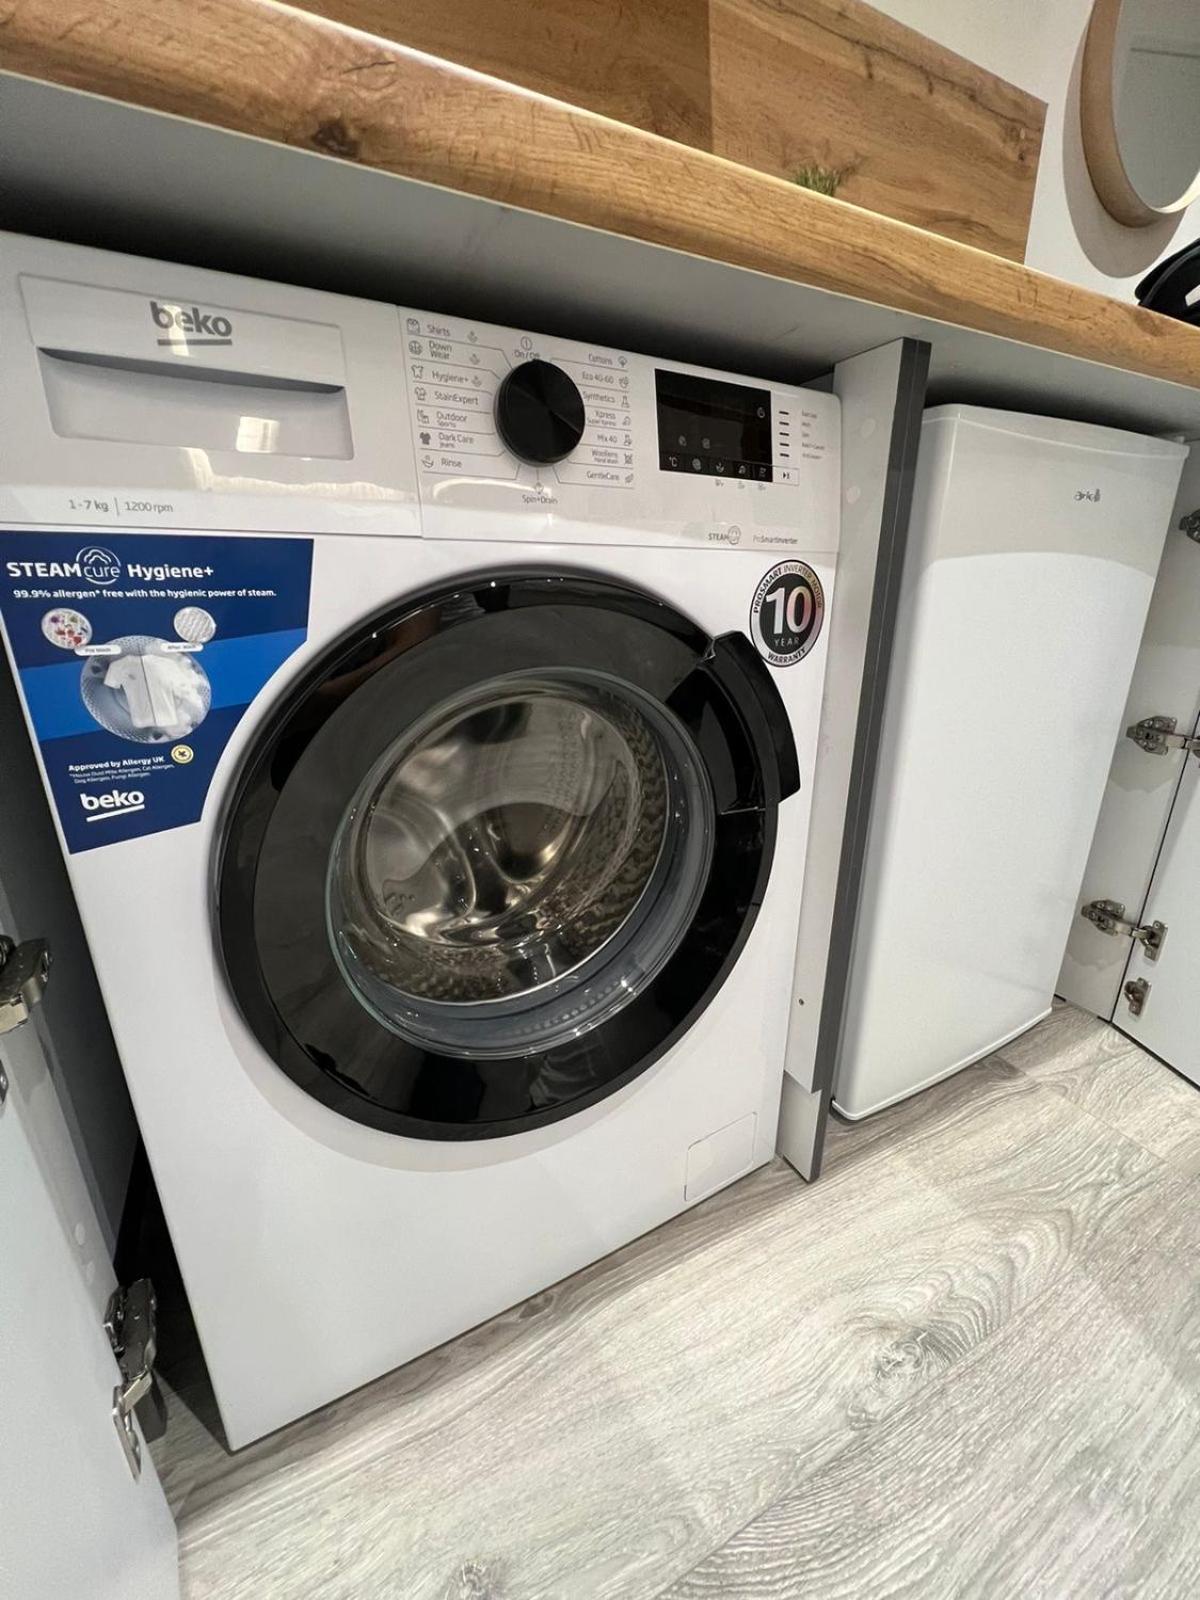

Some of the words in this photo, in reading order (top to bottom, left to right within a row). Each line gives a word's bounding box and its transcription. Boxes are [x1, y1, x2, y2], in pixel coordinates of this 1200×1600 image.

[150, 301, 233, 338] beko
[426, 323, 451, 337] Shirts
[428, 340, 453, 352] Down
[430, 351, 450, 360] Wear
[432, 370, 469, 383] Hygiene+
[434, 391, 479, 405] StainExpert
[436, 411, 468, 422] Outdoor
[608, 435, 618, 443] 40
[441, 458, 463, 468] Rinse
[94, 499, 109, 513] kg
[127, 563, 214, 581] Hygiene+
[13, 589, 51, 599] 99.9%
[102, 589, 124, 598] free
[125, 589, 148, 598] with
[149, 589, 166, 598] the
[167, 589, 206, 600] hygienic
[208, 590, 236, 599] power
[237, 589, 247, 598] of
[248, 589, 277, 598] steam.
[766, 586, 812, 634] 10
[774, 637, 800, 647] YEAR
[767, 647, 806, 664] WARRANTY
[68, 761, 110, 771] Approved
[122, 758, 151, 767] Allergy
[80, 790, 145, 810] beko
